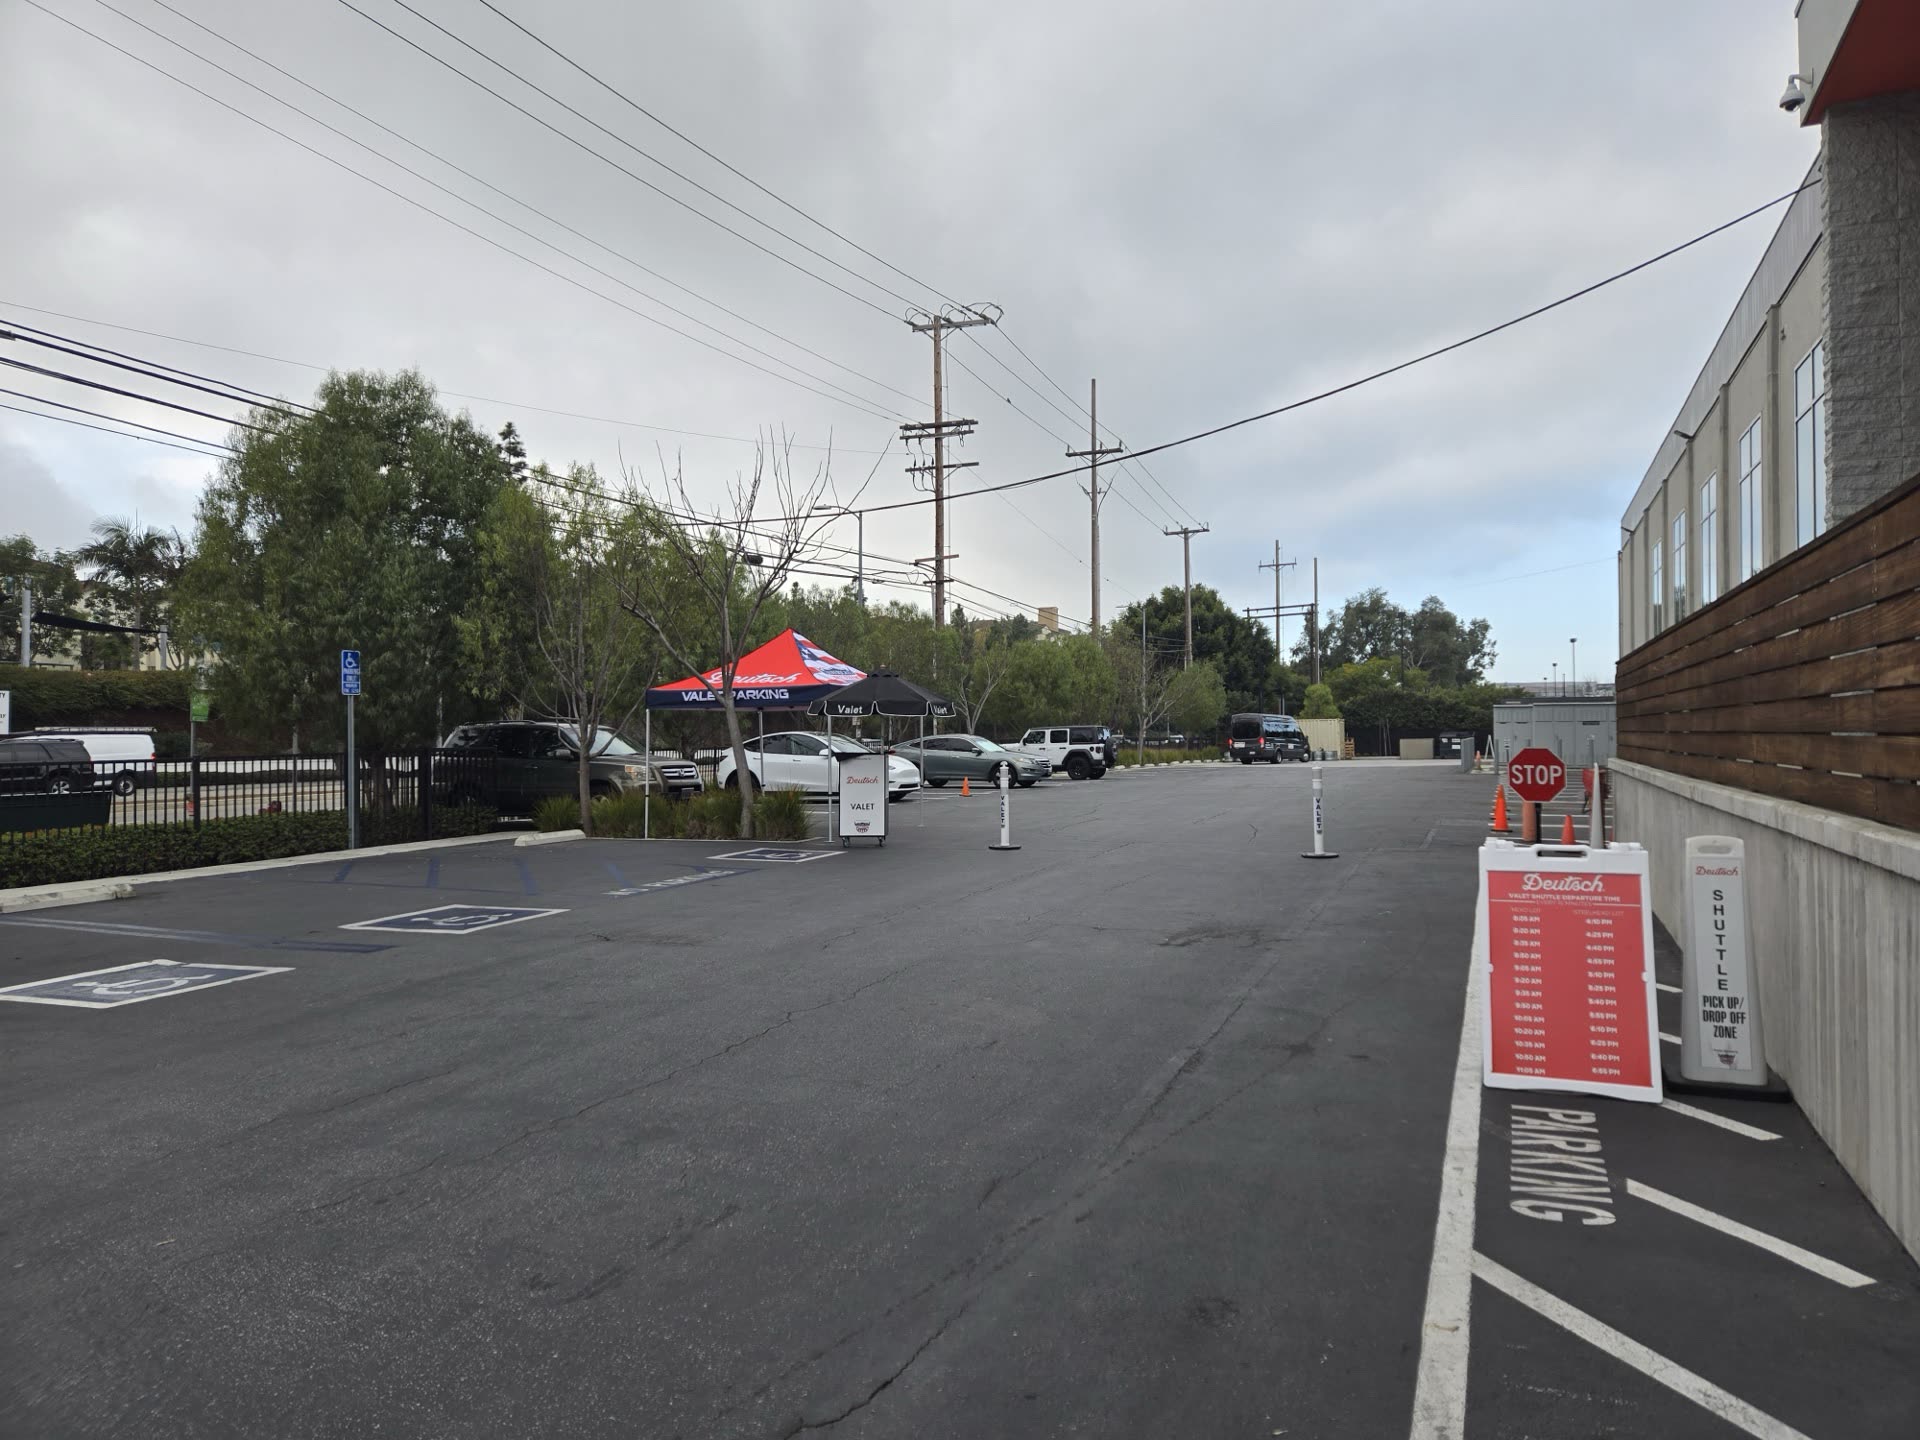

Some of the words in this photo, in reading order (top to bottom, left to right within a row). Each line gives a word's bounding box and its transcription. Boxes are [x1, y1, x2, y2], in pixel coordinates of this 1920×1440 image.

[837, 704, 863, 714] Valet
[846, 775, 879, 784] Deutsch
[1511, 764, 1562, 785] STOP
[850, 803, 875, 811] VALET
[1695, 865, 1739, 876] Deutsch
[1522, 873, 1604, 892] Deutsch
[1712, 889, 1729, 991] SHUTTLE
[1605, 998, 1617, 1006] PM
[1703, 995, 1724, 1009] PICK
[1726, 996, 1745, 1010] UP/
[1533, 1015, 1544, 1023] AM
[1702, 1009, 1727, 1023] DROP
[1729, 1011, 1747, 1024] OFF
[1713, 1025, 1738, 1039] ZONE
[1534, 1054, 1546, 1062] AM
[1608, 1053, 1620, 1061] PM
[1608, 1067, 1620, 1075] PM
[1509, 1103, 1617, 1226] PARKING
